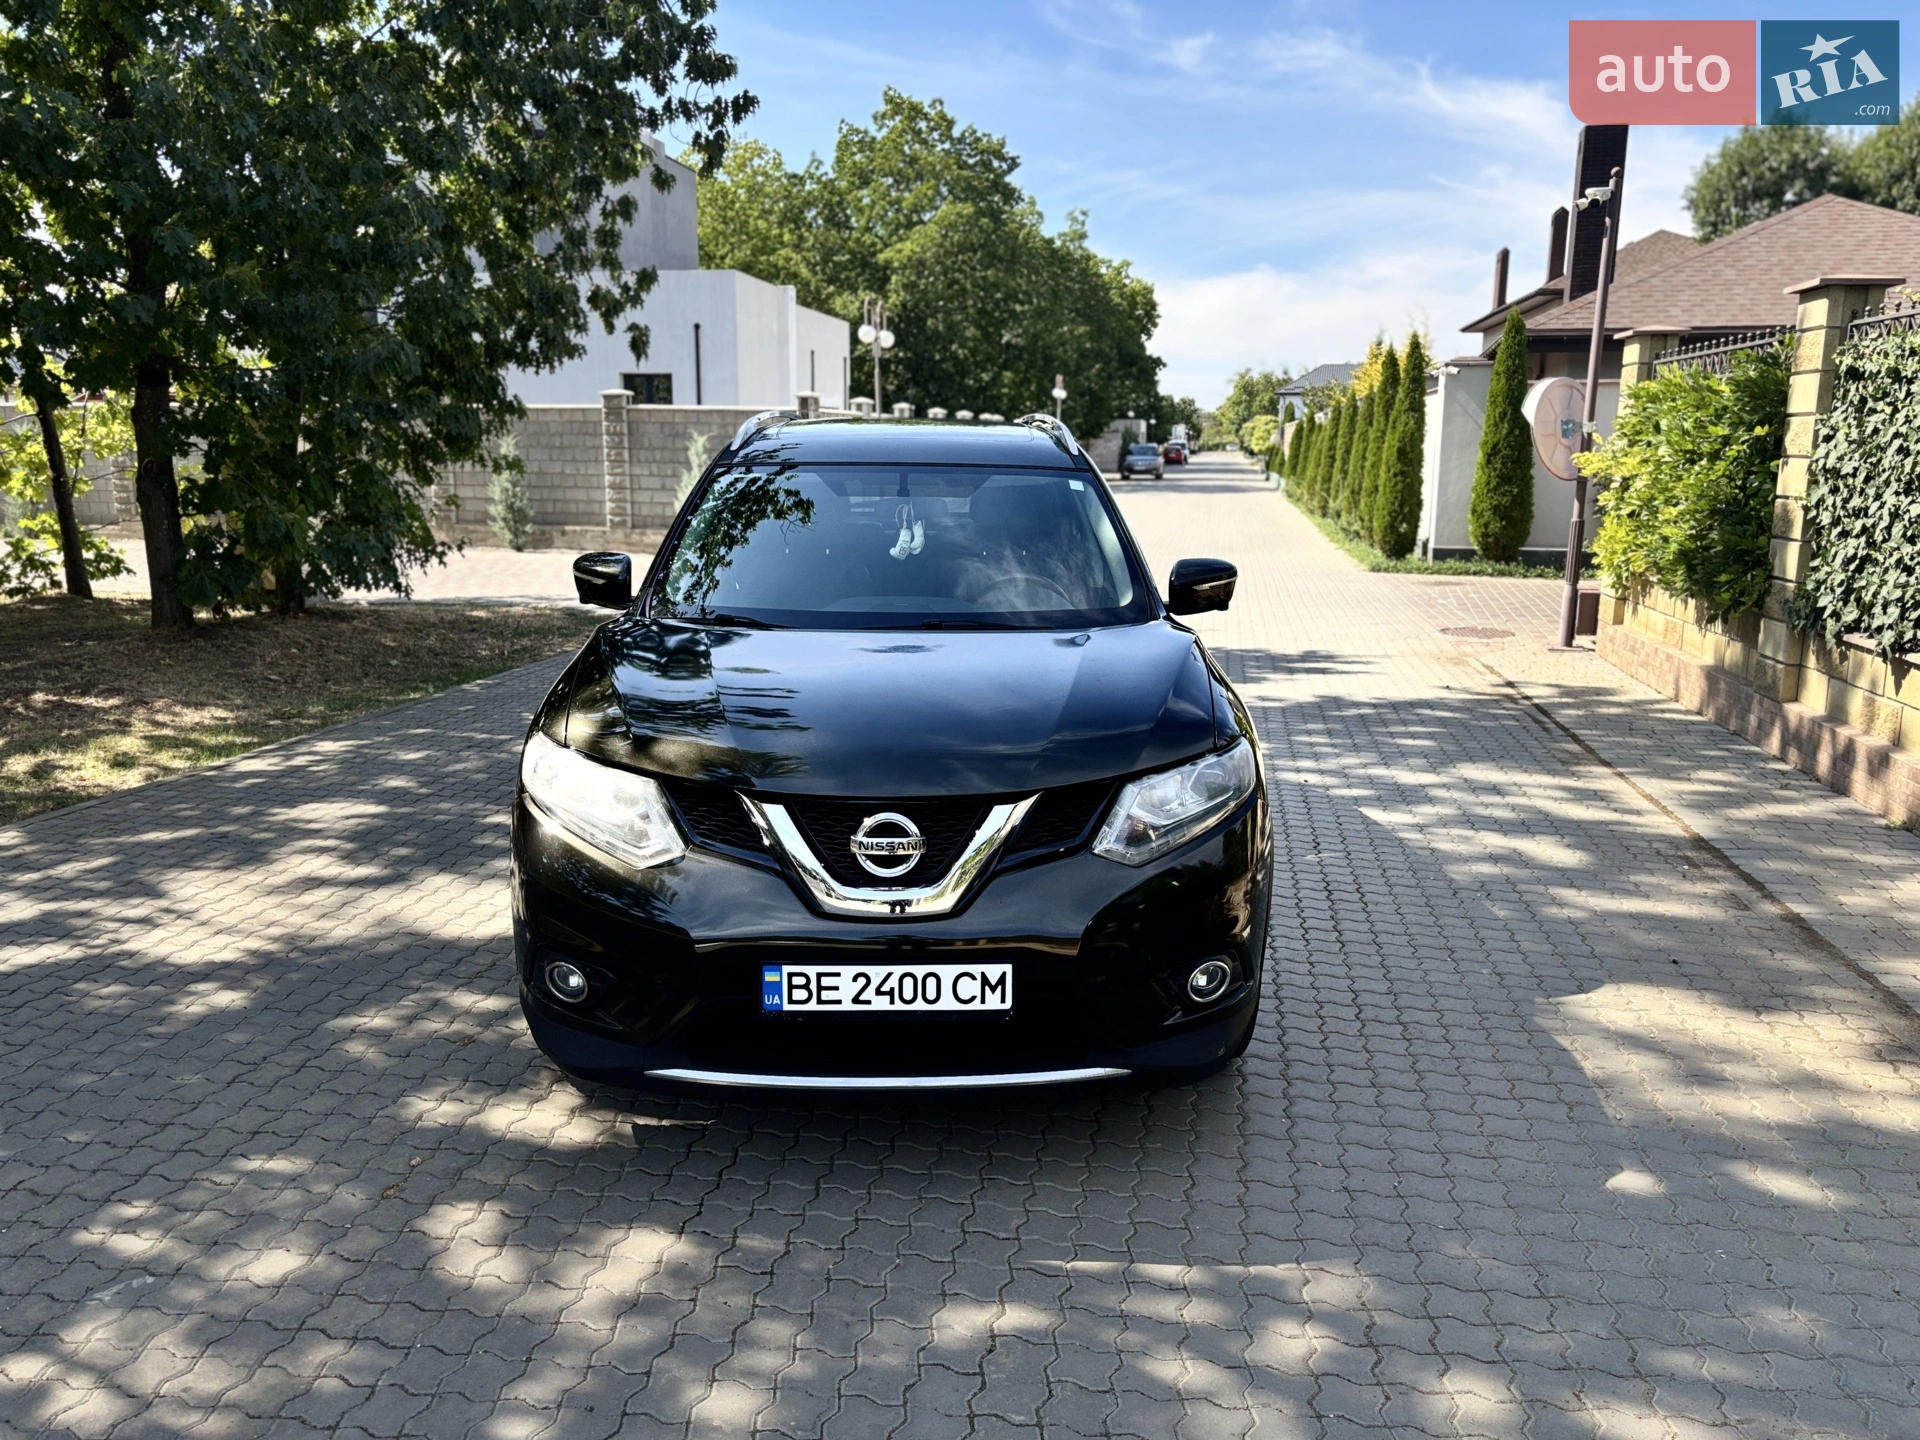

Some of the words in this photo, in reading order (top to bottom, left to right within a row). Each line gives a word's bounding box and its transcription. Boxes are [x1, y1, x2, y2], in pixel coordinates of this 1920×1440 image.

[858, 841, 918, 852] NISSAN
[786, 971, 843, 1006] BE
[851, 971, 942, 1006] 2400
[952, 971, 1007, 1005] CM
[764, 994, 782, 1005] UA
